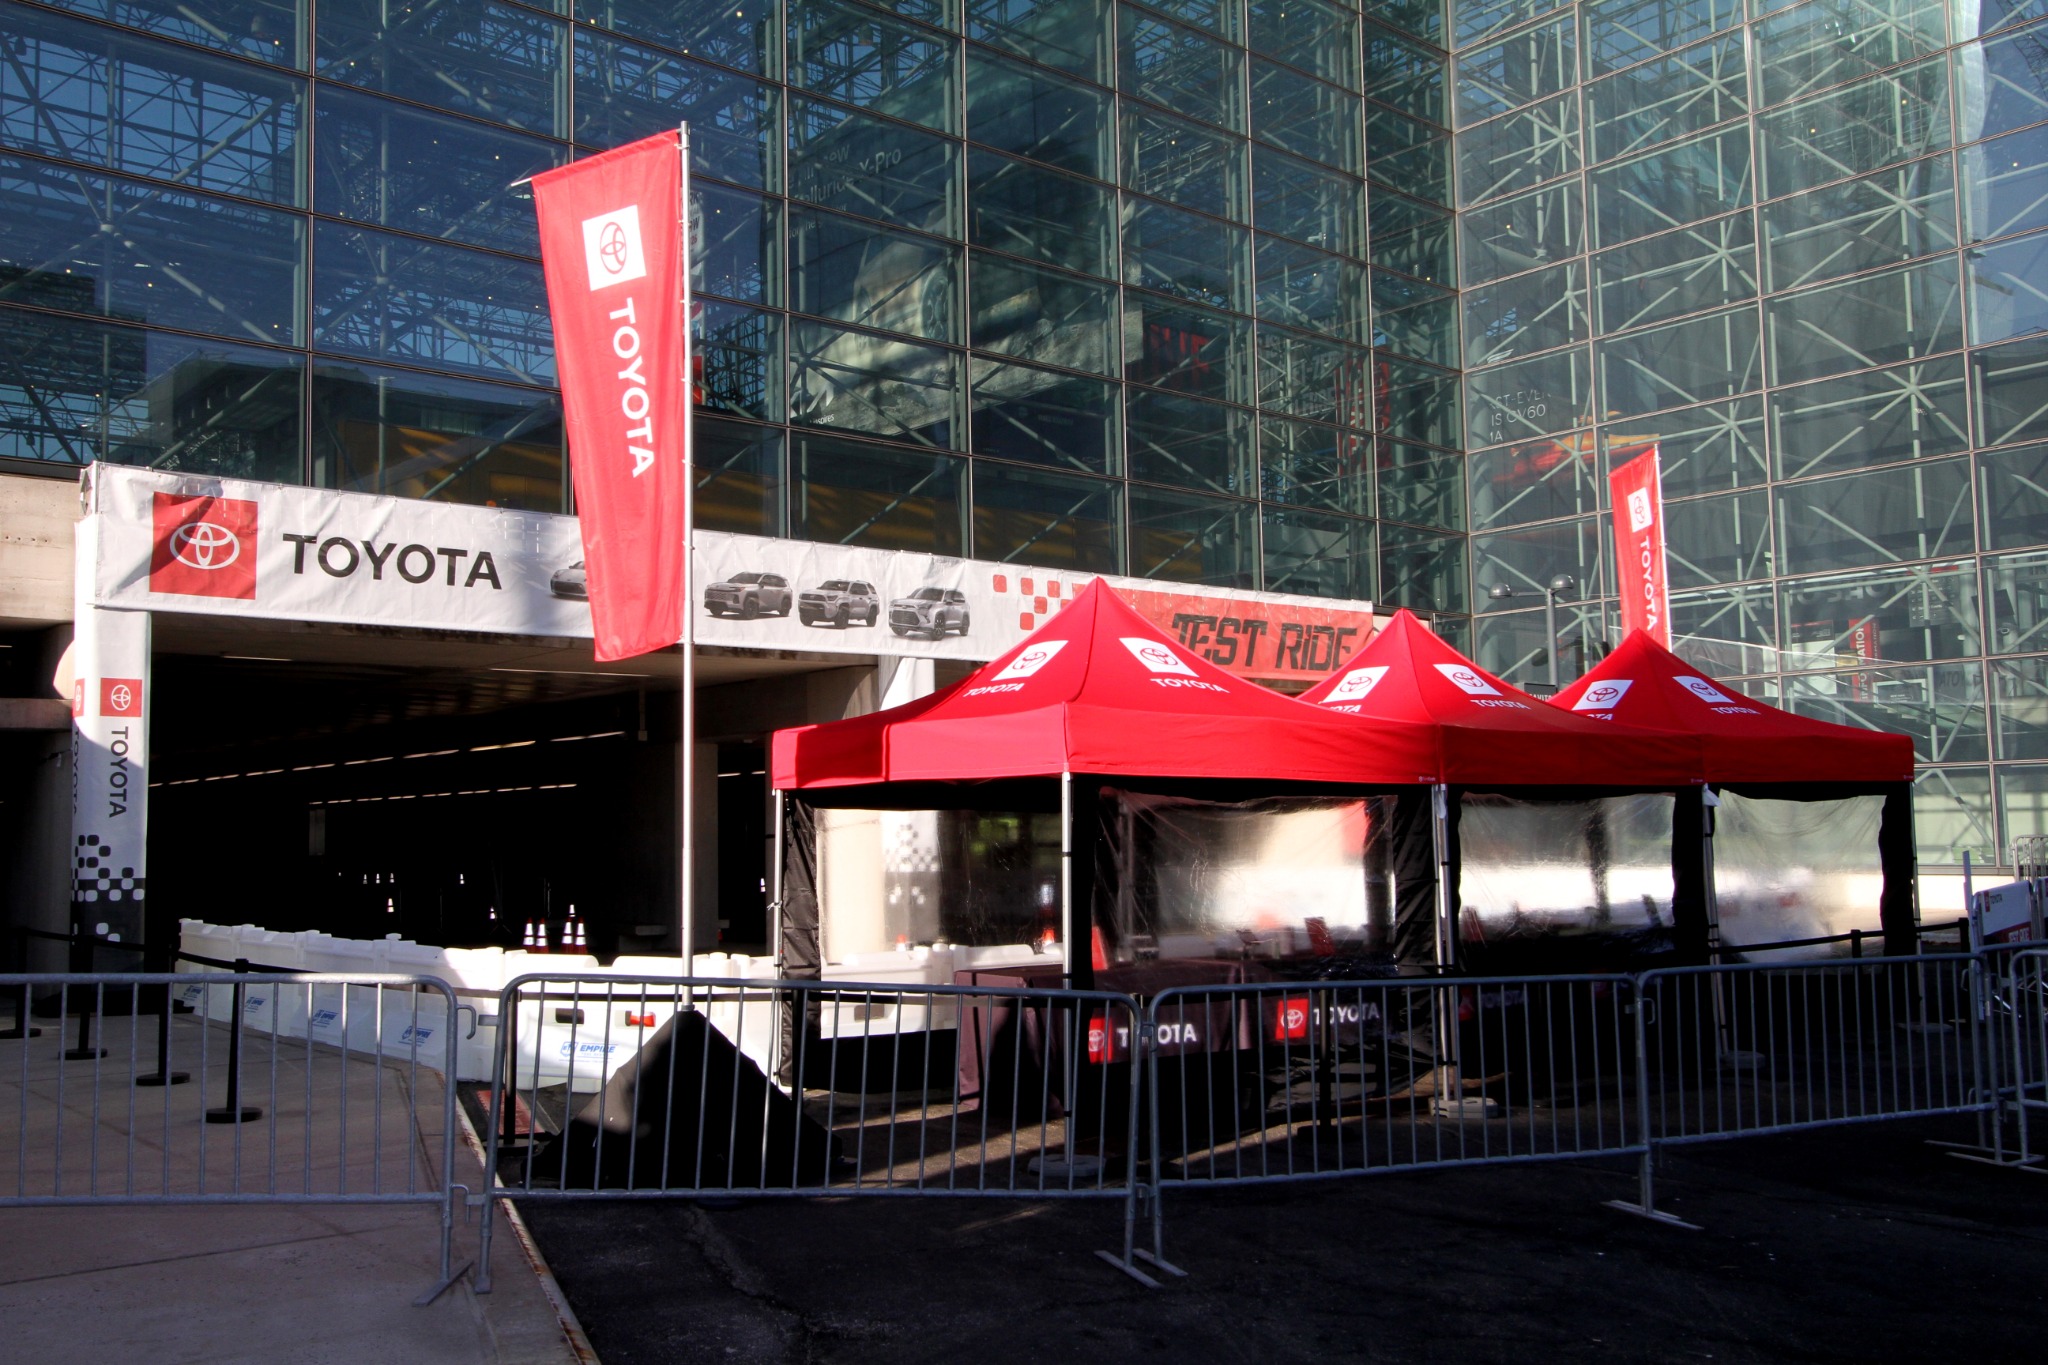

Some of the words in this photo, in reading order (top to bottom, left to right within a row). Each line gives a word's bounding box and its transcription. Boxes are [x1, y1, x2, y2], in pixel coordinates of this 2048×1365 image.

[609, 296, 655, 478] TOYOTA
[282, 532, 503, 590] TOYOTA
[1640, 535, 1658, 631] TOYOTA
[1172, 613, 1268, 668] TEST
[1275, 622, 1358, 672] RIDE
[962, 682, 1025, 698] TOYOTA
[1149, 678, 1231, 694] TOYOTA
[1470, 699, 1532, 710] TOYOTA
[1710, 706, 1761, 715] TOYOTA
[109, 726, 129, 818] TOYOTA
[1117, 1023, 1198, 1048] TOTA
